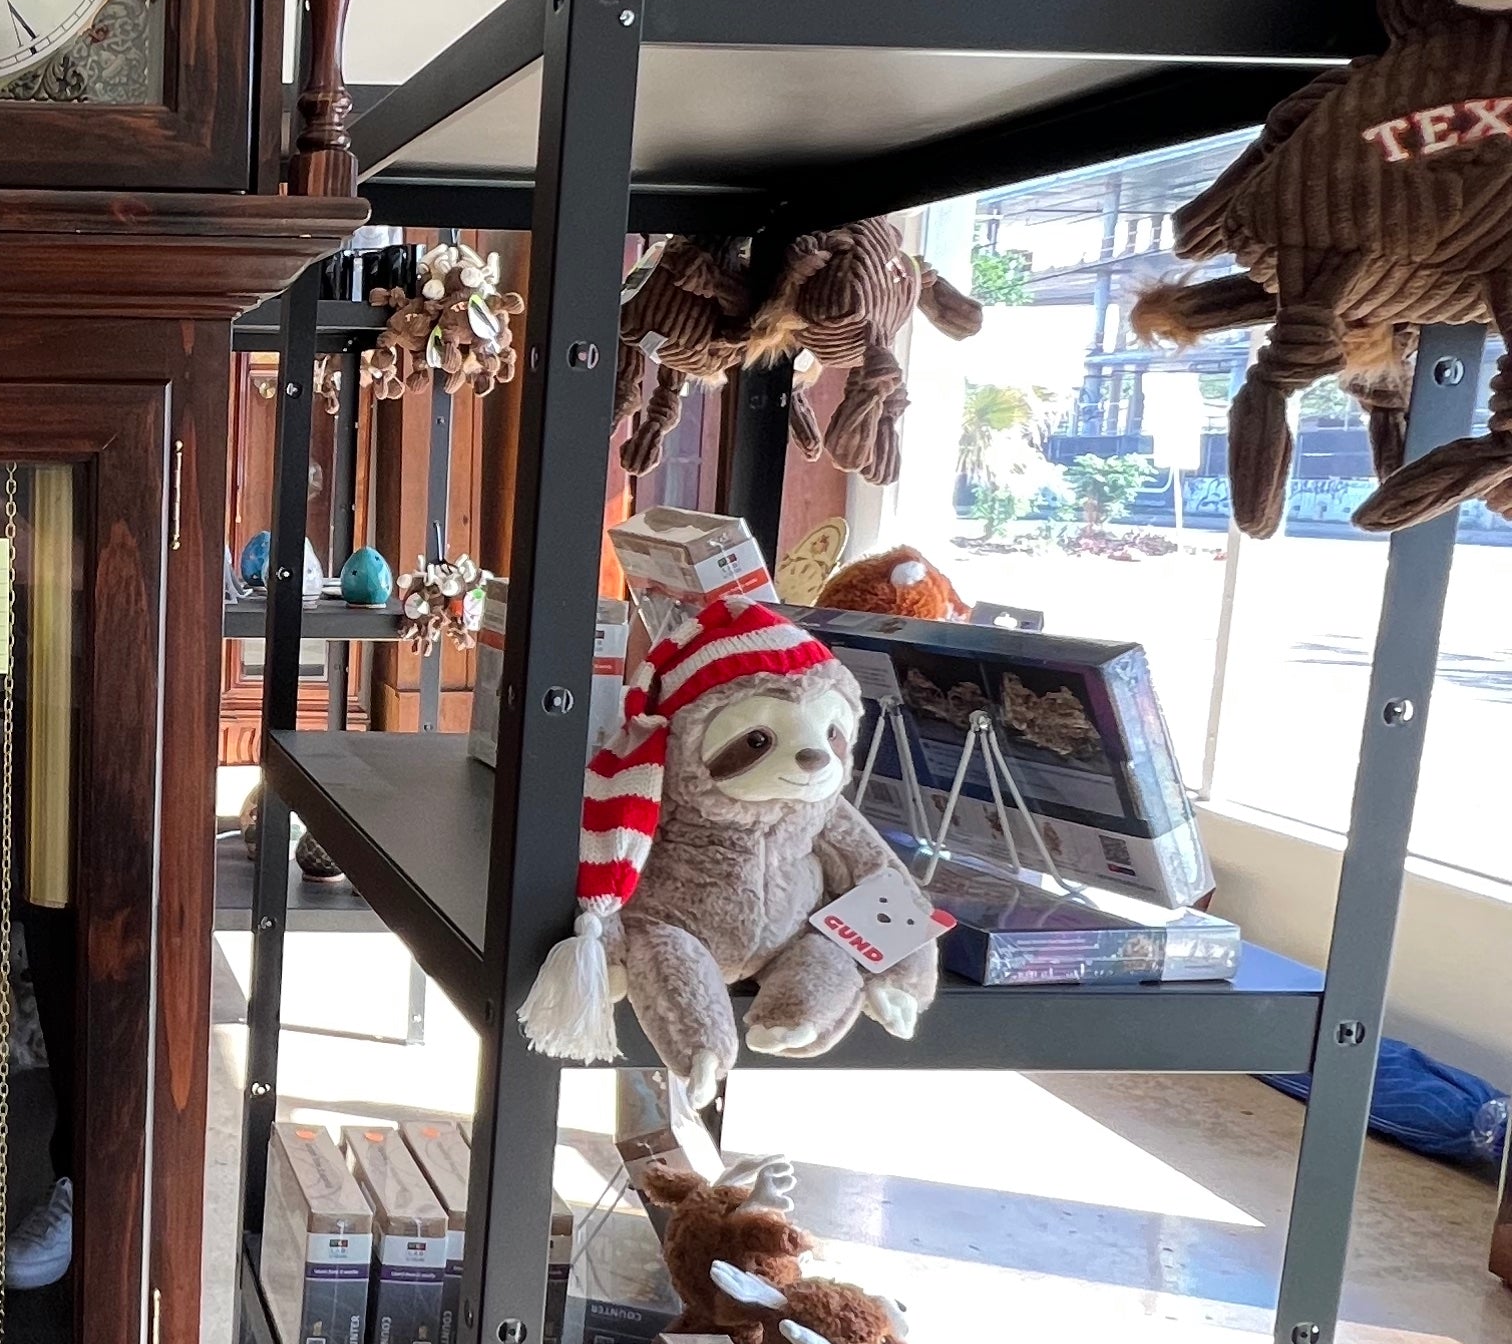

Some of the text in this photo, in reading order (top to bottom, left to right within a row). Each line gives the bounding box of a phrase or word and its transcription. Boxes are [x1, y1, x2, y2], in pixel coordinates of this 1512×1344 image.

[7, 0, 38, 47] V
[824, 915, 884, 962] GUND
[591, 1304, 642, 1321] COUNTER
